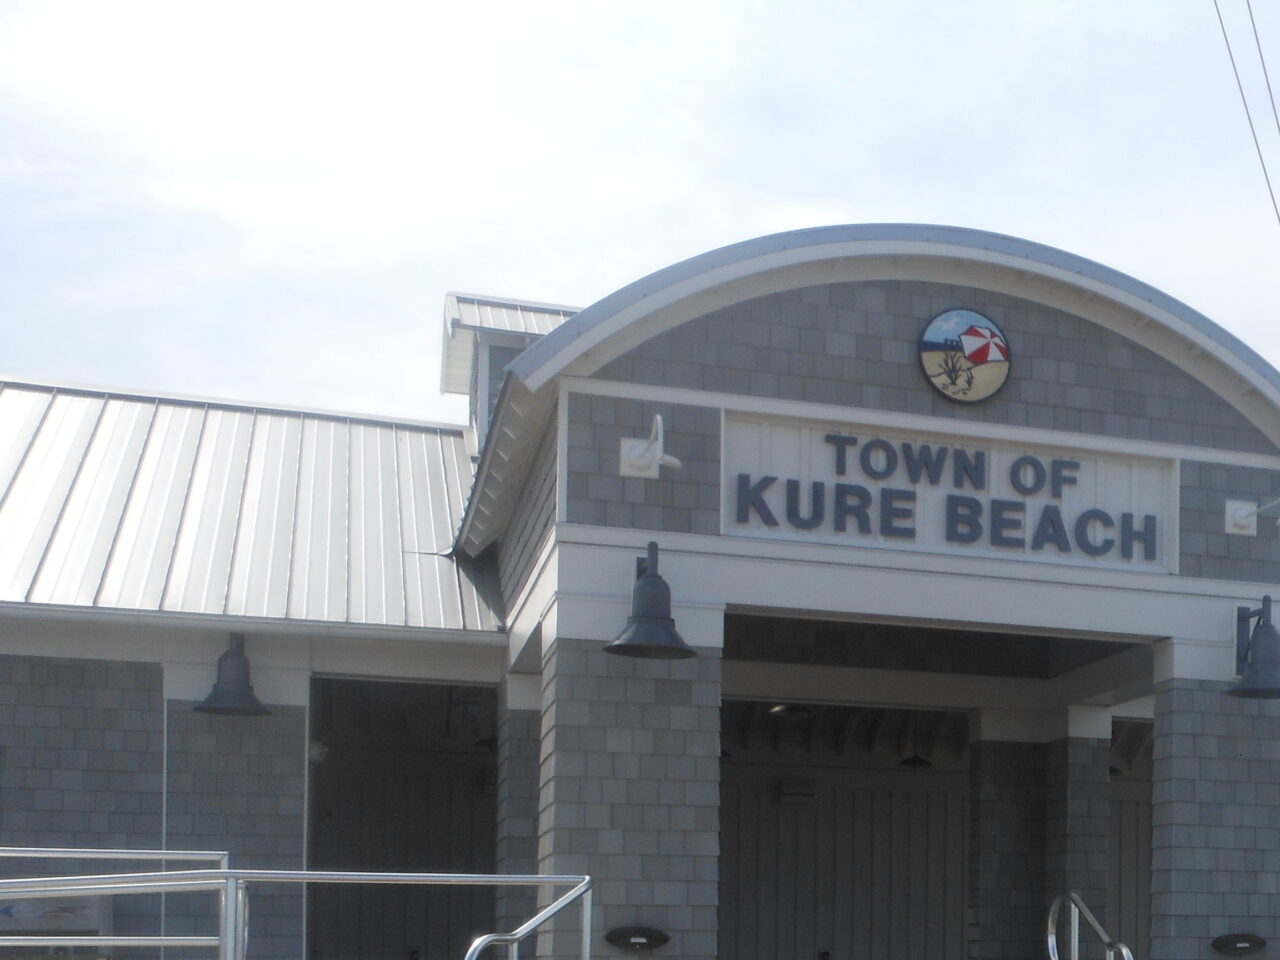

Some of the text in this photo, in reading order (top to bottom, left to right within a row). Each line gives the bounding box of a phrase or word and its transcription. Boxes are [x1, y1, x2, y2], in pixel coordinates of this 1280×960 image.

[825, 433, 1080, 499] TOWN OF
[736, 474, 1157, 561] KURE BEACH
